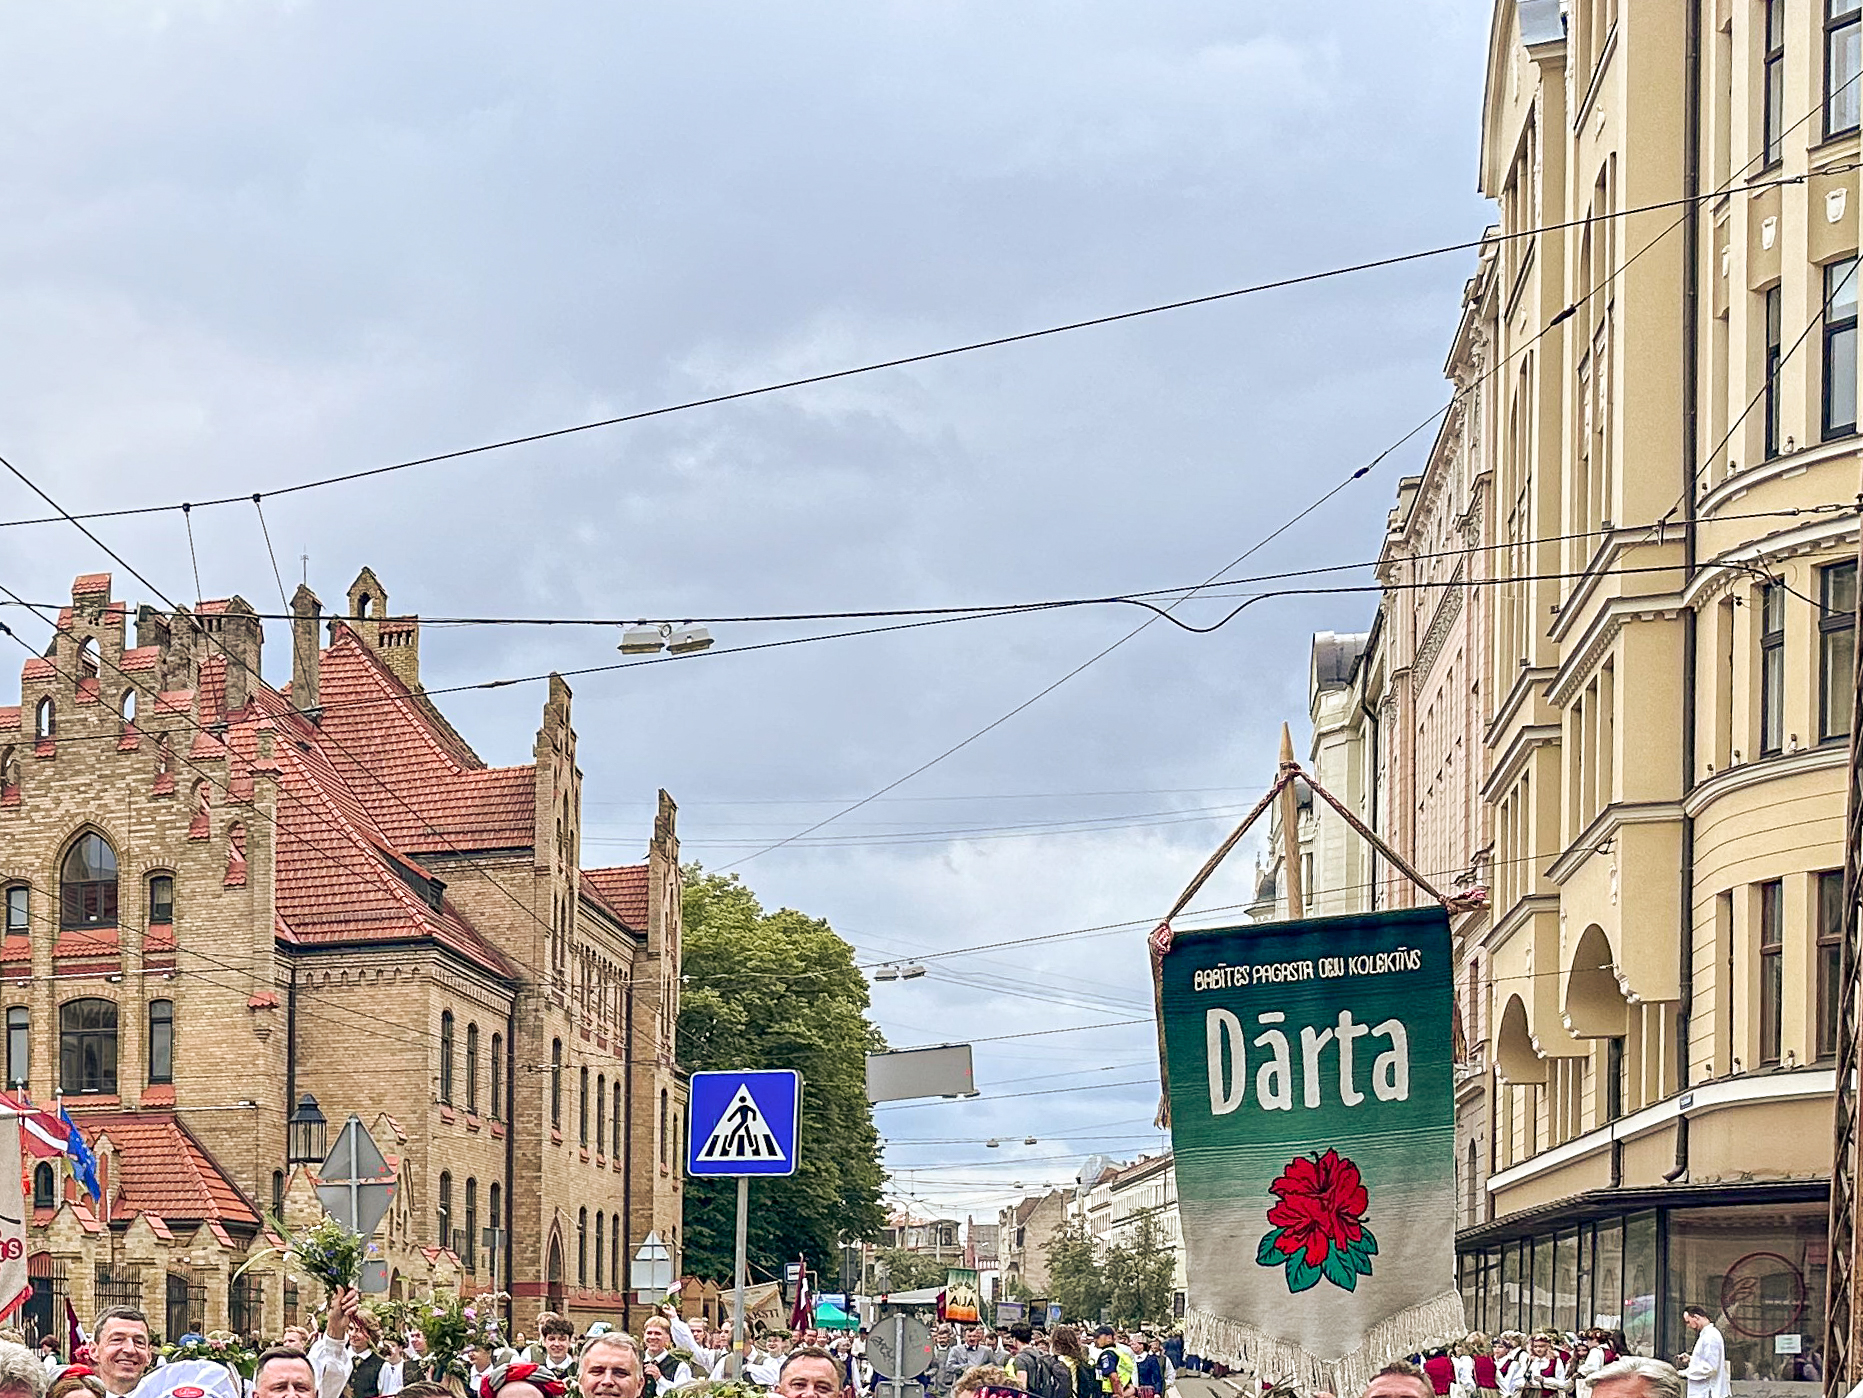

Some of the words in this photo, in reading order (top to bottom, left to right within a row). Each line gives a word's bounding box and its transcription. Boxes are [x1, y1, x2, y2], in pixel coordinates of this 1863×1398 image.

[1194, 963, 1250, 991] BABĪTES
[1253, 961, 1314, 985] PAGASTA
[1318, 957, 1345, 979] DEJU
[1348, 947, 1422, 977] KOLEKTĪVS
[1206, 1008, 1409, 1115] Dārta
